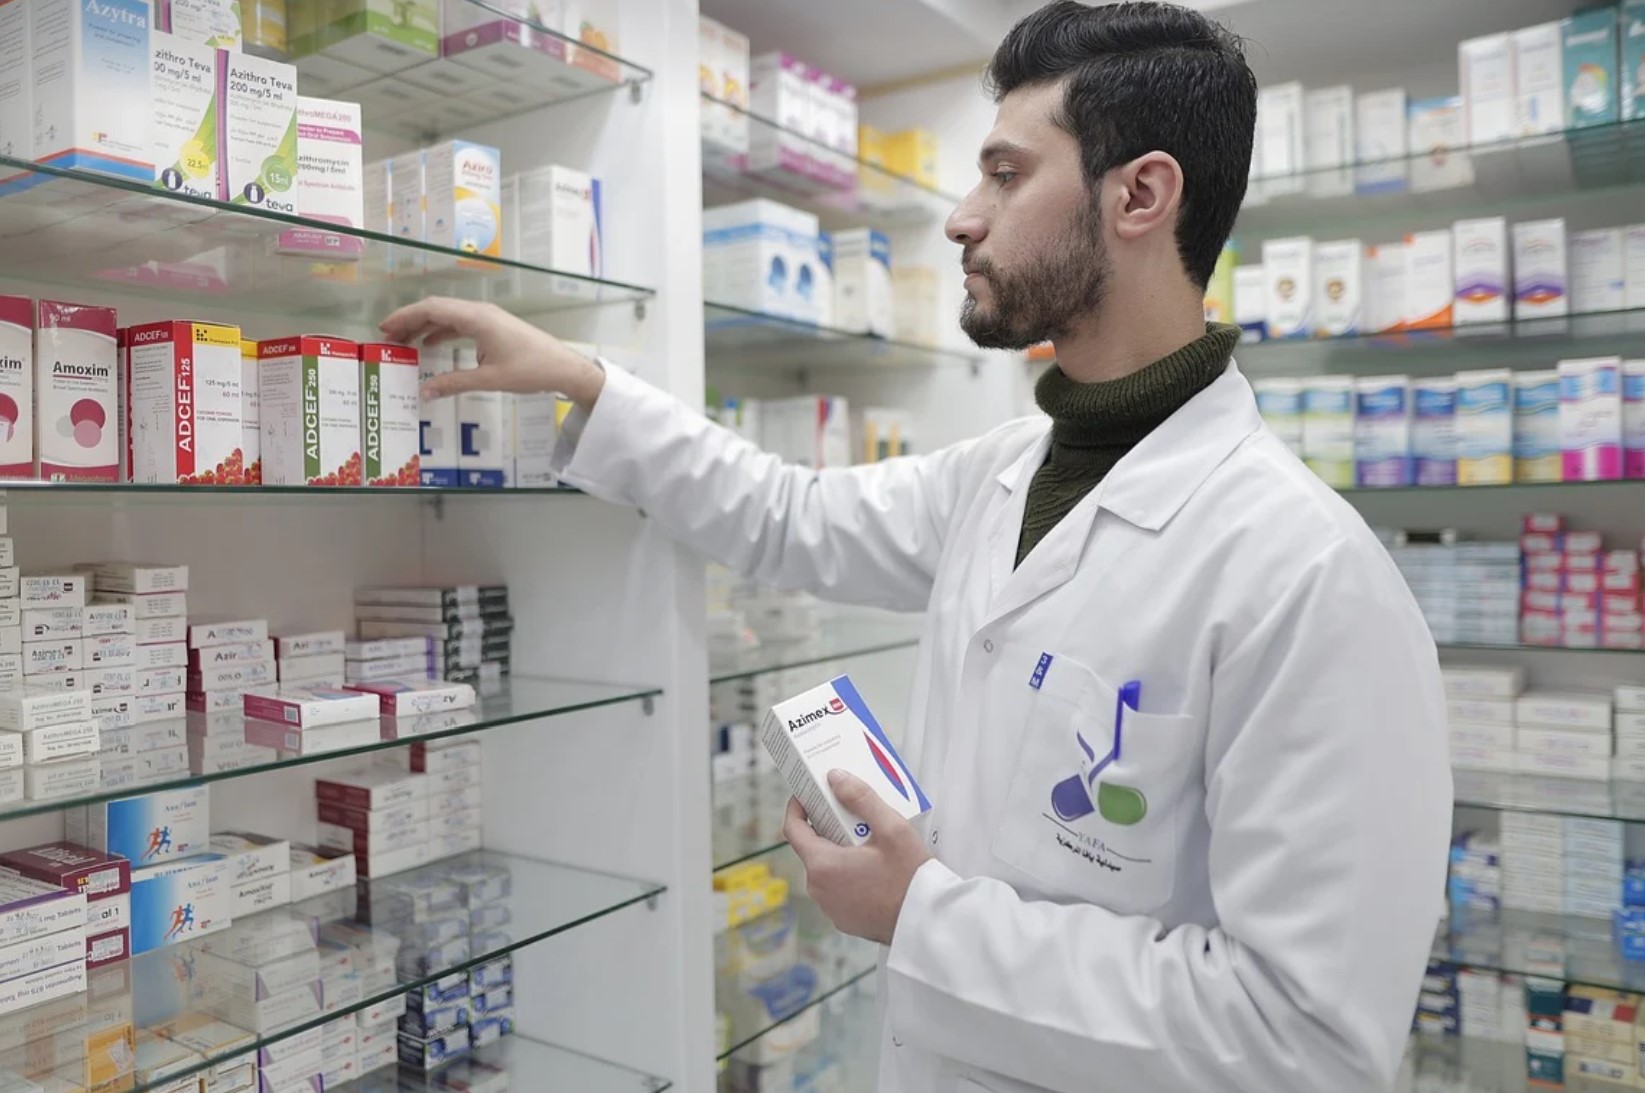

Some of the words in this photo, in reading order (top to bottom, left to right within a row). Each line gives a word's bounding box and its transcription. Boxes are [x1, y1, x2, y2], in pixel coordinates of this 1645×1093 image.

[85, 0, 147, 29] Azytra
[155, 50, 187, 66] zithro
[188, 57, 211, 74] Teva
[167, 67, 190, 81] mg/5
[191, 74, 202, 83] ml
[229, 68, 267, 85] Azithro
[269, 77, 293, 92] Teva
[230, 80, 248, 94] 200
[249, 87, 272, 99] mg/5
[273, 92, 283, 101] ml
[184, 185, 212, 199] teva
[266, 198, 293, 212] teva
[134, 330, 160, 342] ADCEF
[262, 343, 289, 355] ADCEF
[53, 361, 109, 377] Amoxim
[180, 357, 191, 377] 125
[307, 368, 317, 388] 250
[369, 374, 378, 393] 250
[178, 376, 192, 453] ADCEF
[305, 387, 319, 460] ADCEF
[367, 393, 379, 462] ADCEF
[787, 705, 829, 733] Azimex
[1078, 831, 1106, 853] YAFA
